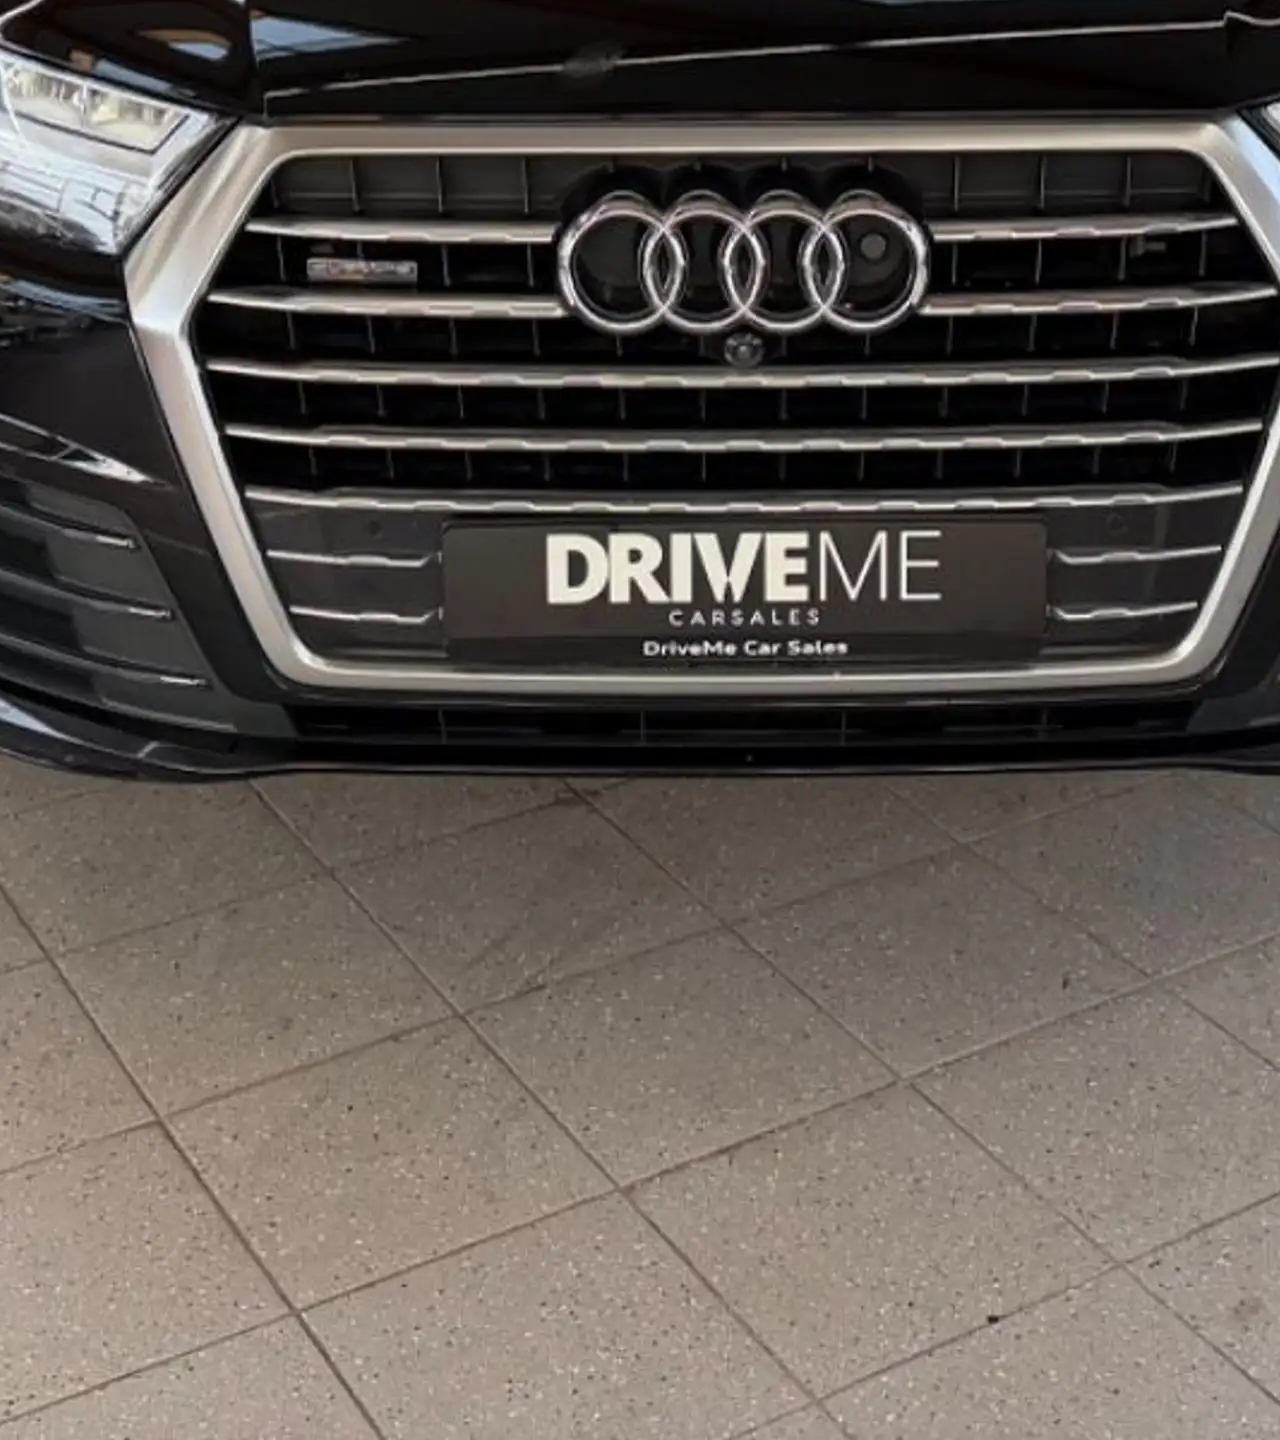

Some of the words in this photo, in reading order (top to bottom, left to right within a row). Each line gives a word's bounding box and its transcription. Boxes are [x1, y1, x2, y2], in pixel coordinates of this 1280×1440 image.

[546, 530, 942, 604] DRIVEME
[668, 608, 820, 627] CARSALES
[642, 639, 738, 657] DriveMe
[743, 639, 782, 657] Car
[787, 639, 848, 657] Sales
